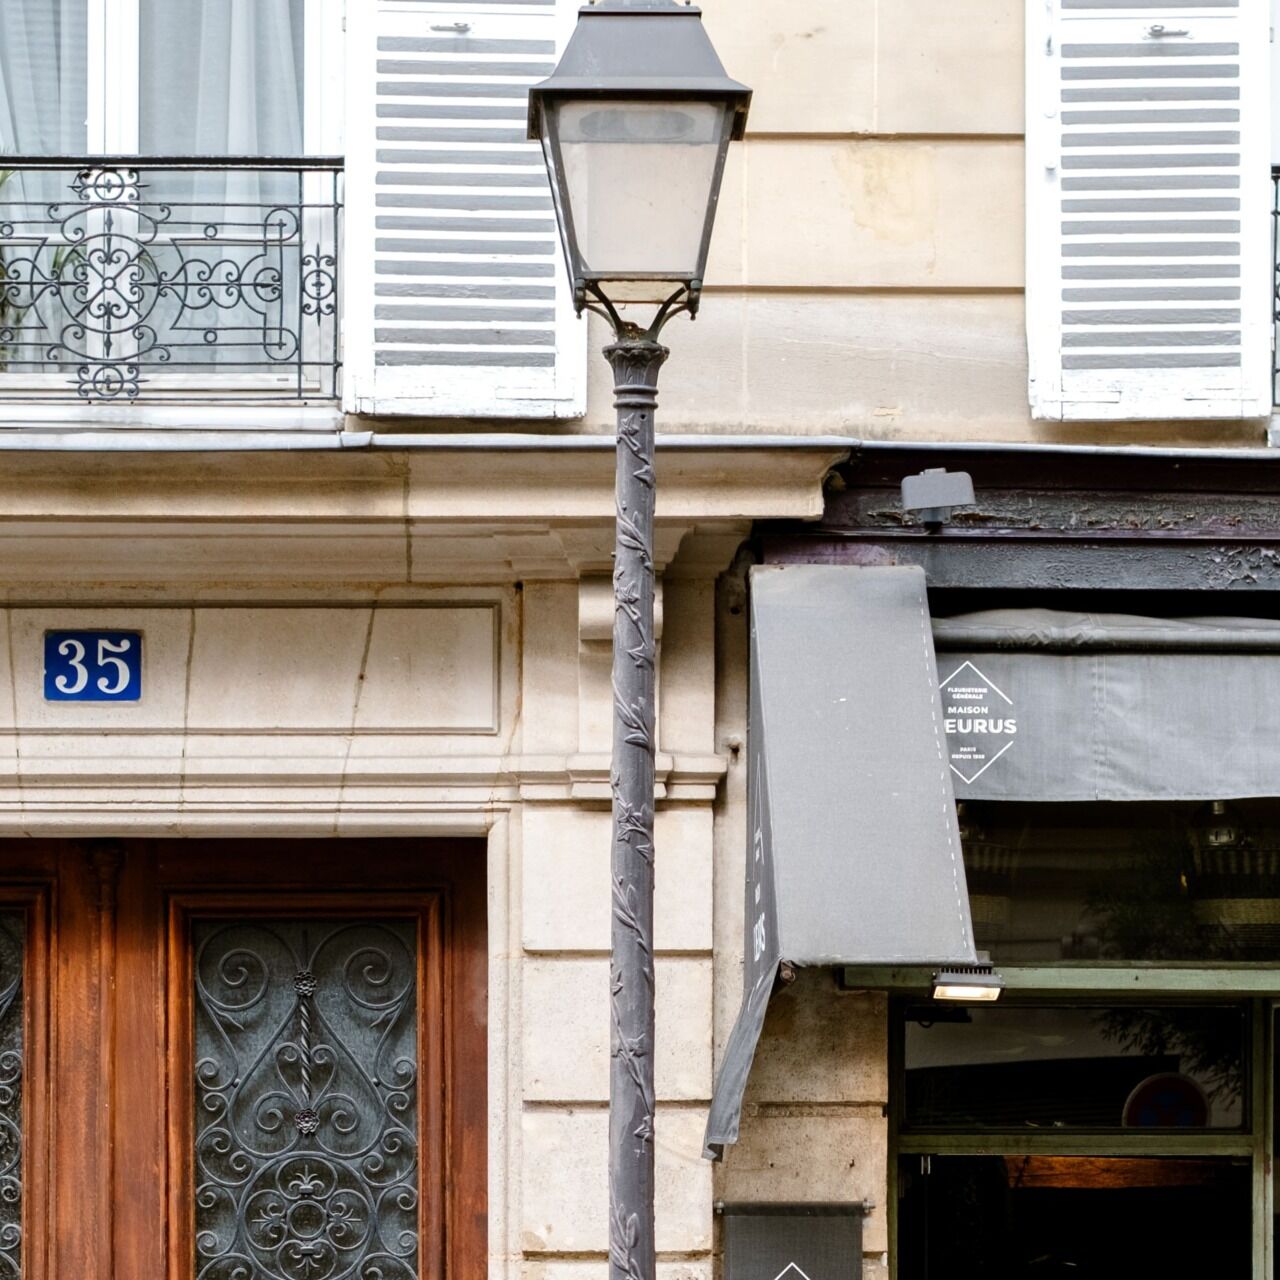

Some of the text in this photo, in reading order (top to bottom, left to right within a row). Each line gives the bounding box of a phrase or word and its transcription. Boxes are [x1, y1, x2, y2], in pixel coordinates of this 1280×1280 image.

[55, 638, 131, 694] 35
[948, 706, 988, 714] MAISON
[944, 718, 1017, 734] EURUS
